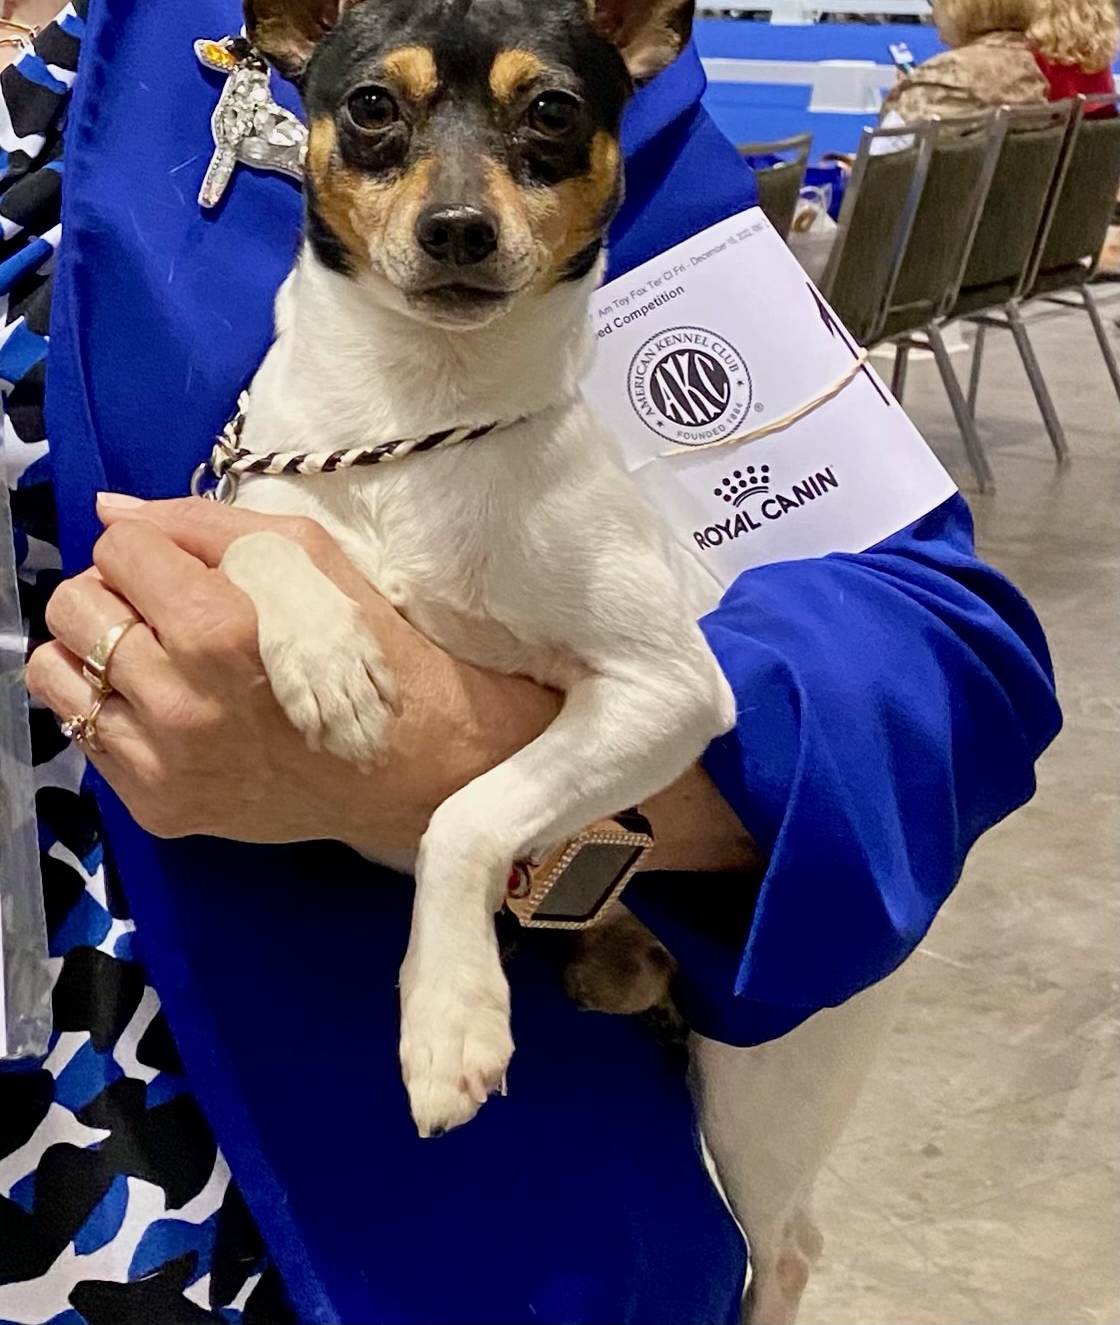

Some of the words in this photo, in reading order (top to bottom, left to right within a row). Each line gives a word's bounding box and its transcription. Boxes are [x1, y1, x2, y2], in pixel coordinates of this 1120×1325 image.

[613, 295, 630, 309] Toy
[690, 242, 728, 266] December
[596, 324, 613, 340] ed
[613, 285, 685, 329] Competition
[634, 349, 657, 416] AMERICAN
[655, 333, 709, 351] KENNEL
[711, 342, 739, 373] CLUB
[654, 352, 728, 424] AKC
[677, 424, 727, 441] FOUNDED
[727, 402, 744, 424] 1884
[693, 511, 762, 550] ROYAL
[761, 467, 838, 520] CANIN
